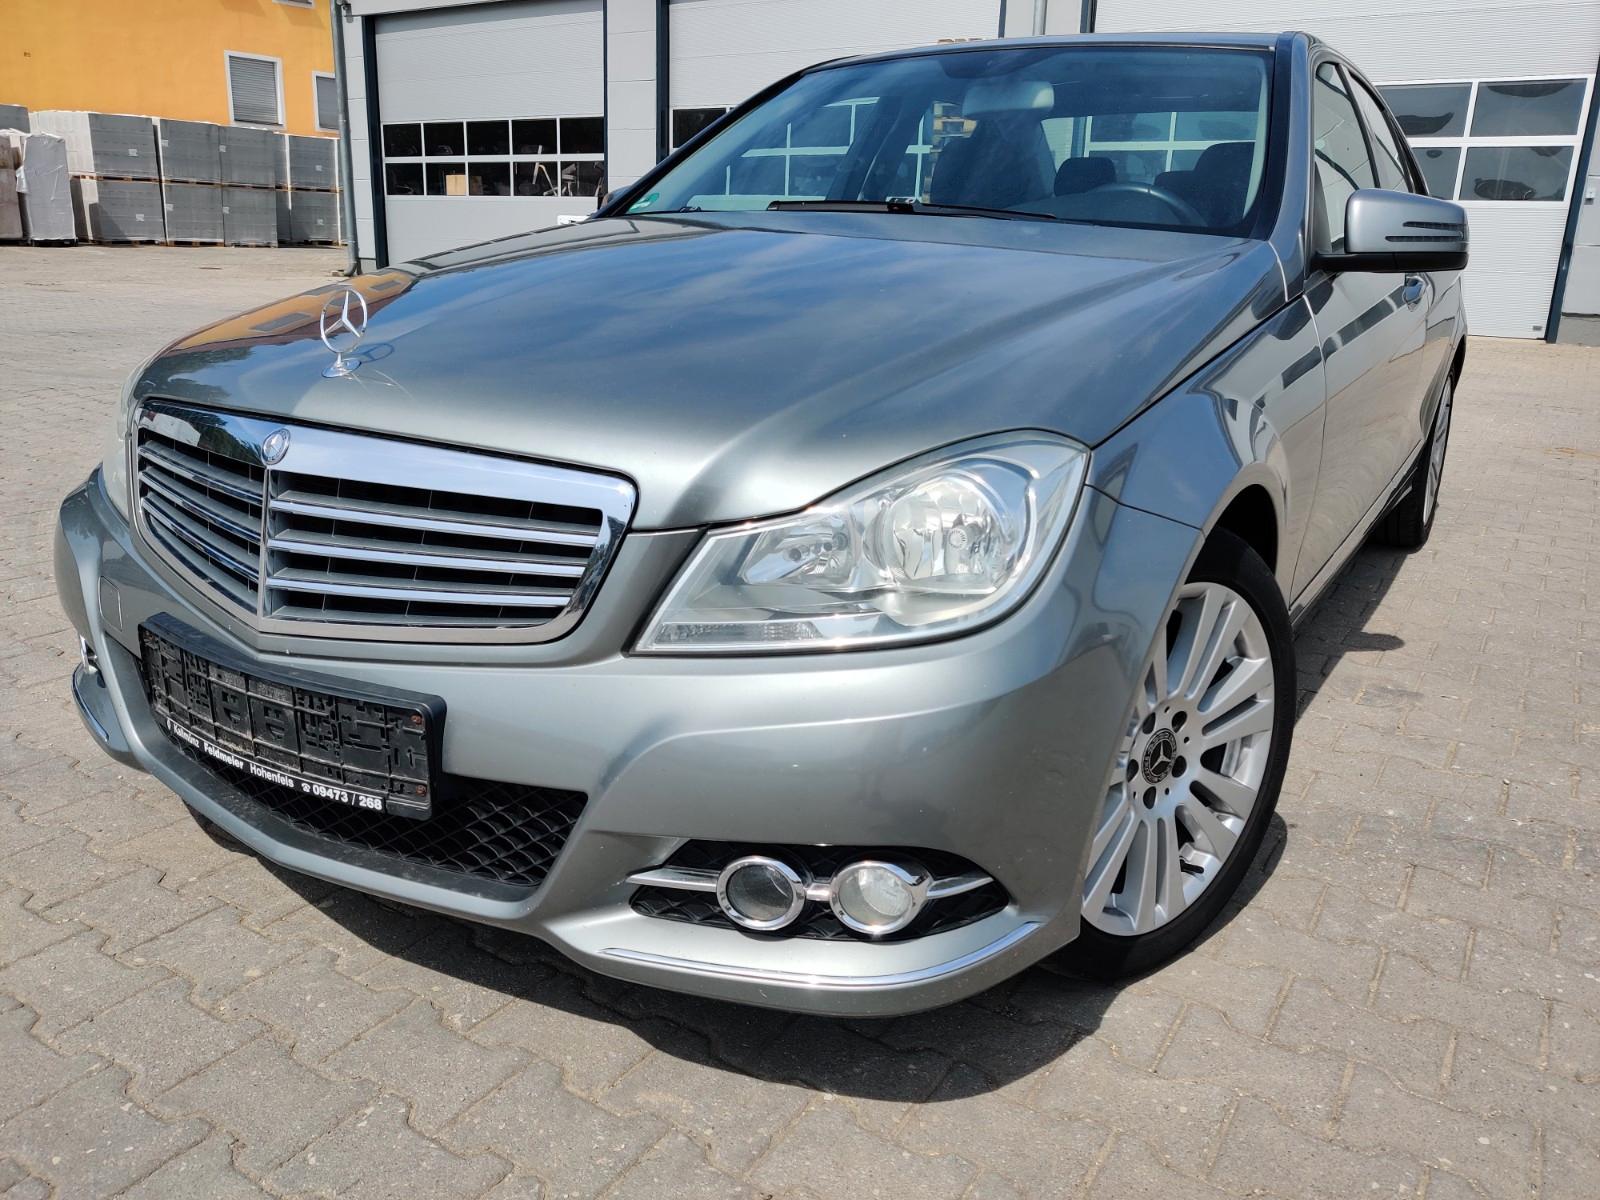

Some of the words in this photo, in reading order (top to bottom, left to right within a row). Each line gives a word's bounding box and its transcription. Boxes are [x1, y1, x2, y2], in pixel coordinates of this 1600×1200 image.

[203, 741, 244, 770] Feldmeier
[249, 763, 294, 788] Hohenfels
[312, 785, 348, 803] 09473
[358, 795, 383, 811] 268
